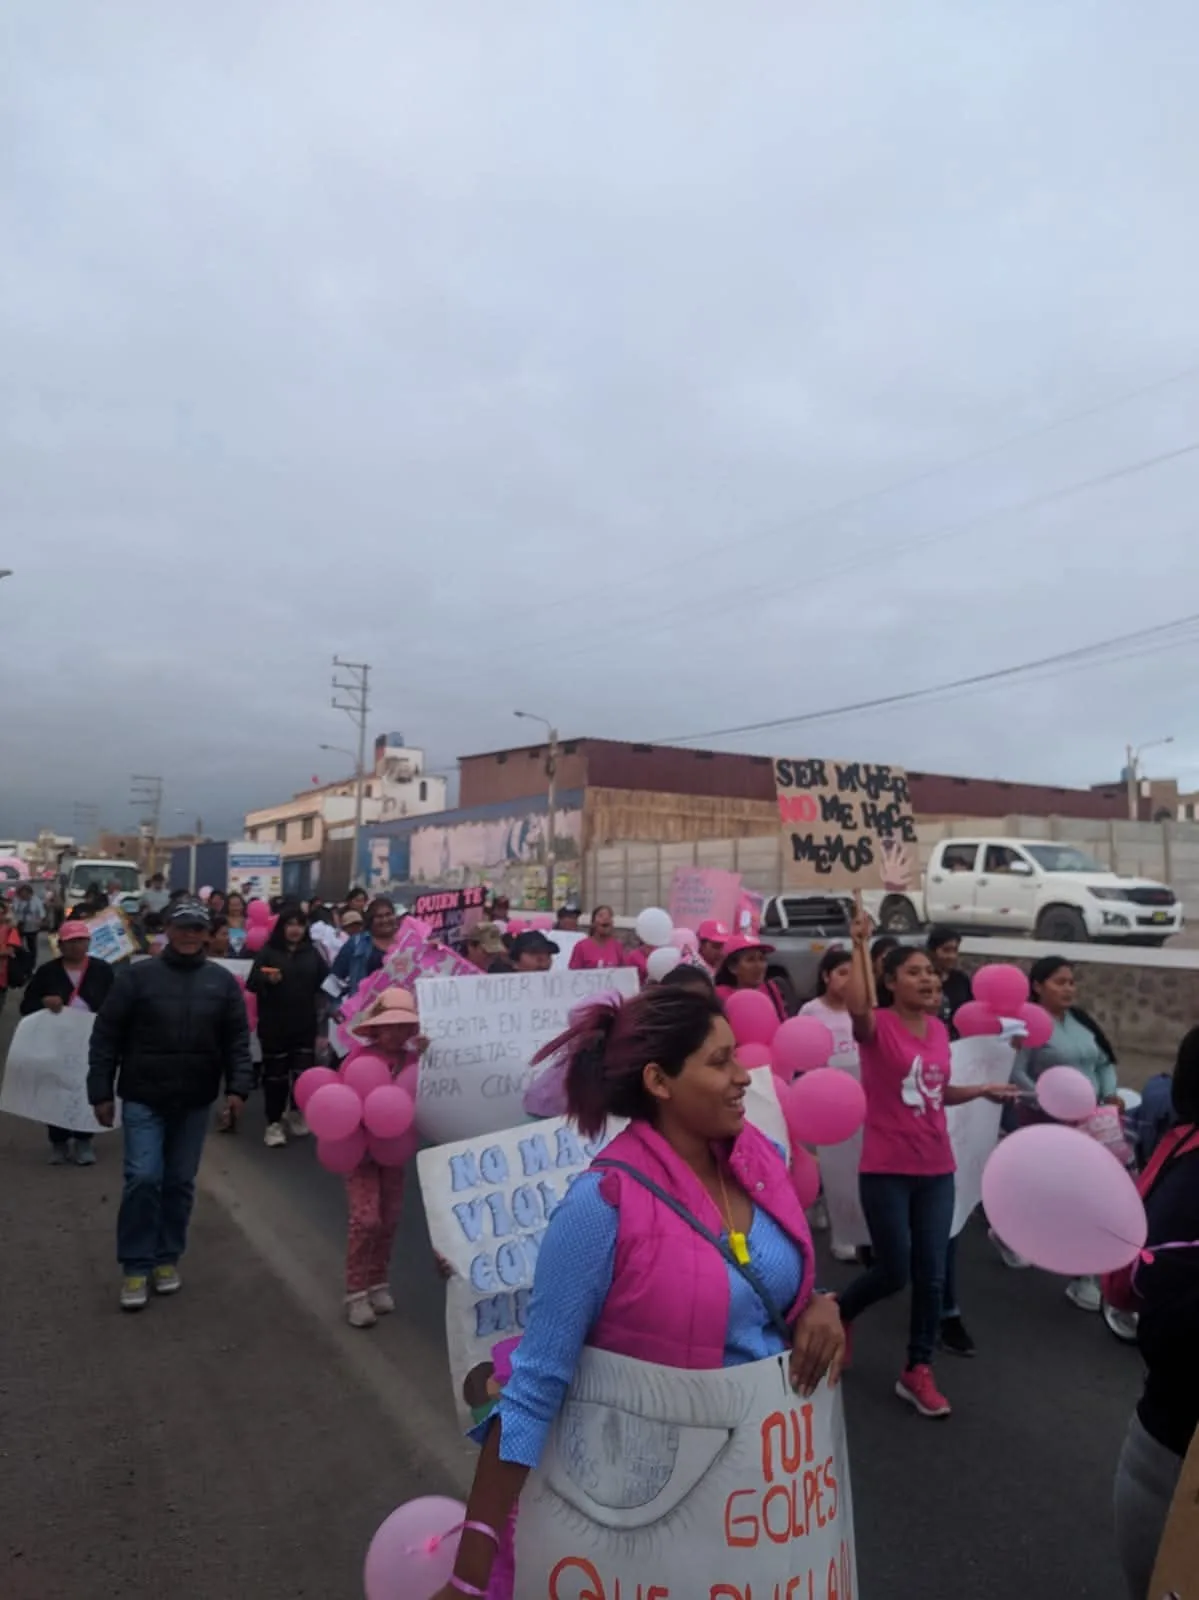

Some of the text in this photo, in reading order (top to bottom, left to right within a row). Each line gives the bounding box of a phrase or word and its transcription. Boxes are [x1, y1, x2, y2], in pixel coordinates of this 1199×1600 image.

[776, 758, 828, 789] SER
[777, 793, 818, 824] NO
[818, 794, 858, 830] ME
[790, 832, 875, 874] MENOS
[475, 975, 532, 1003] MUJER
[542, 974, 562, 999] NO
[499, 1012, 521, 1034] EN
[421, 1038, 521, 1071] NECESITAS
[419, 1076, 462, 1100] PARA
[449, 1145, 509, 1192] NO
[761, 1403, 814, 1483] NI
[724, 1455, 838, 1547] GOLPES
